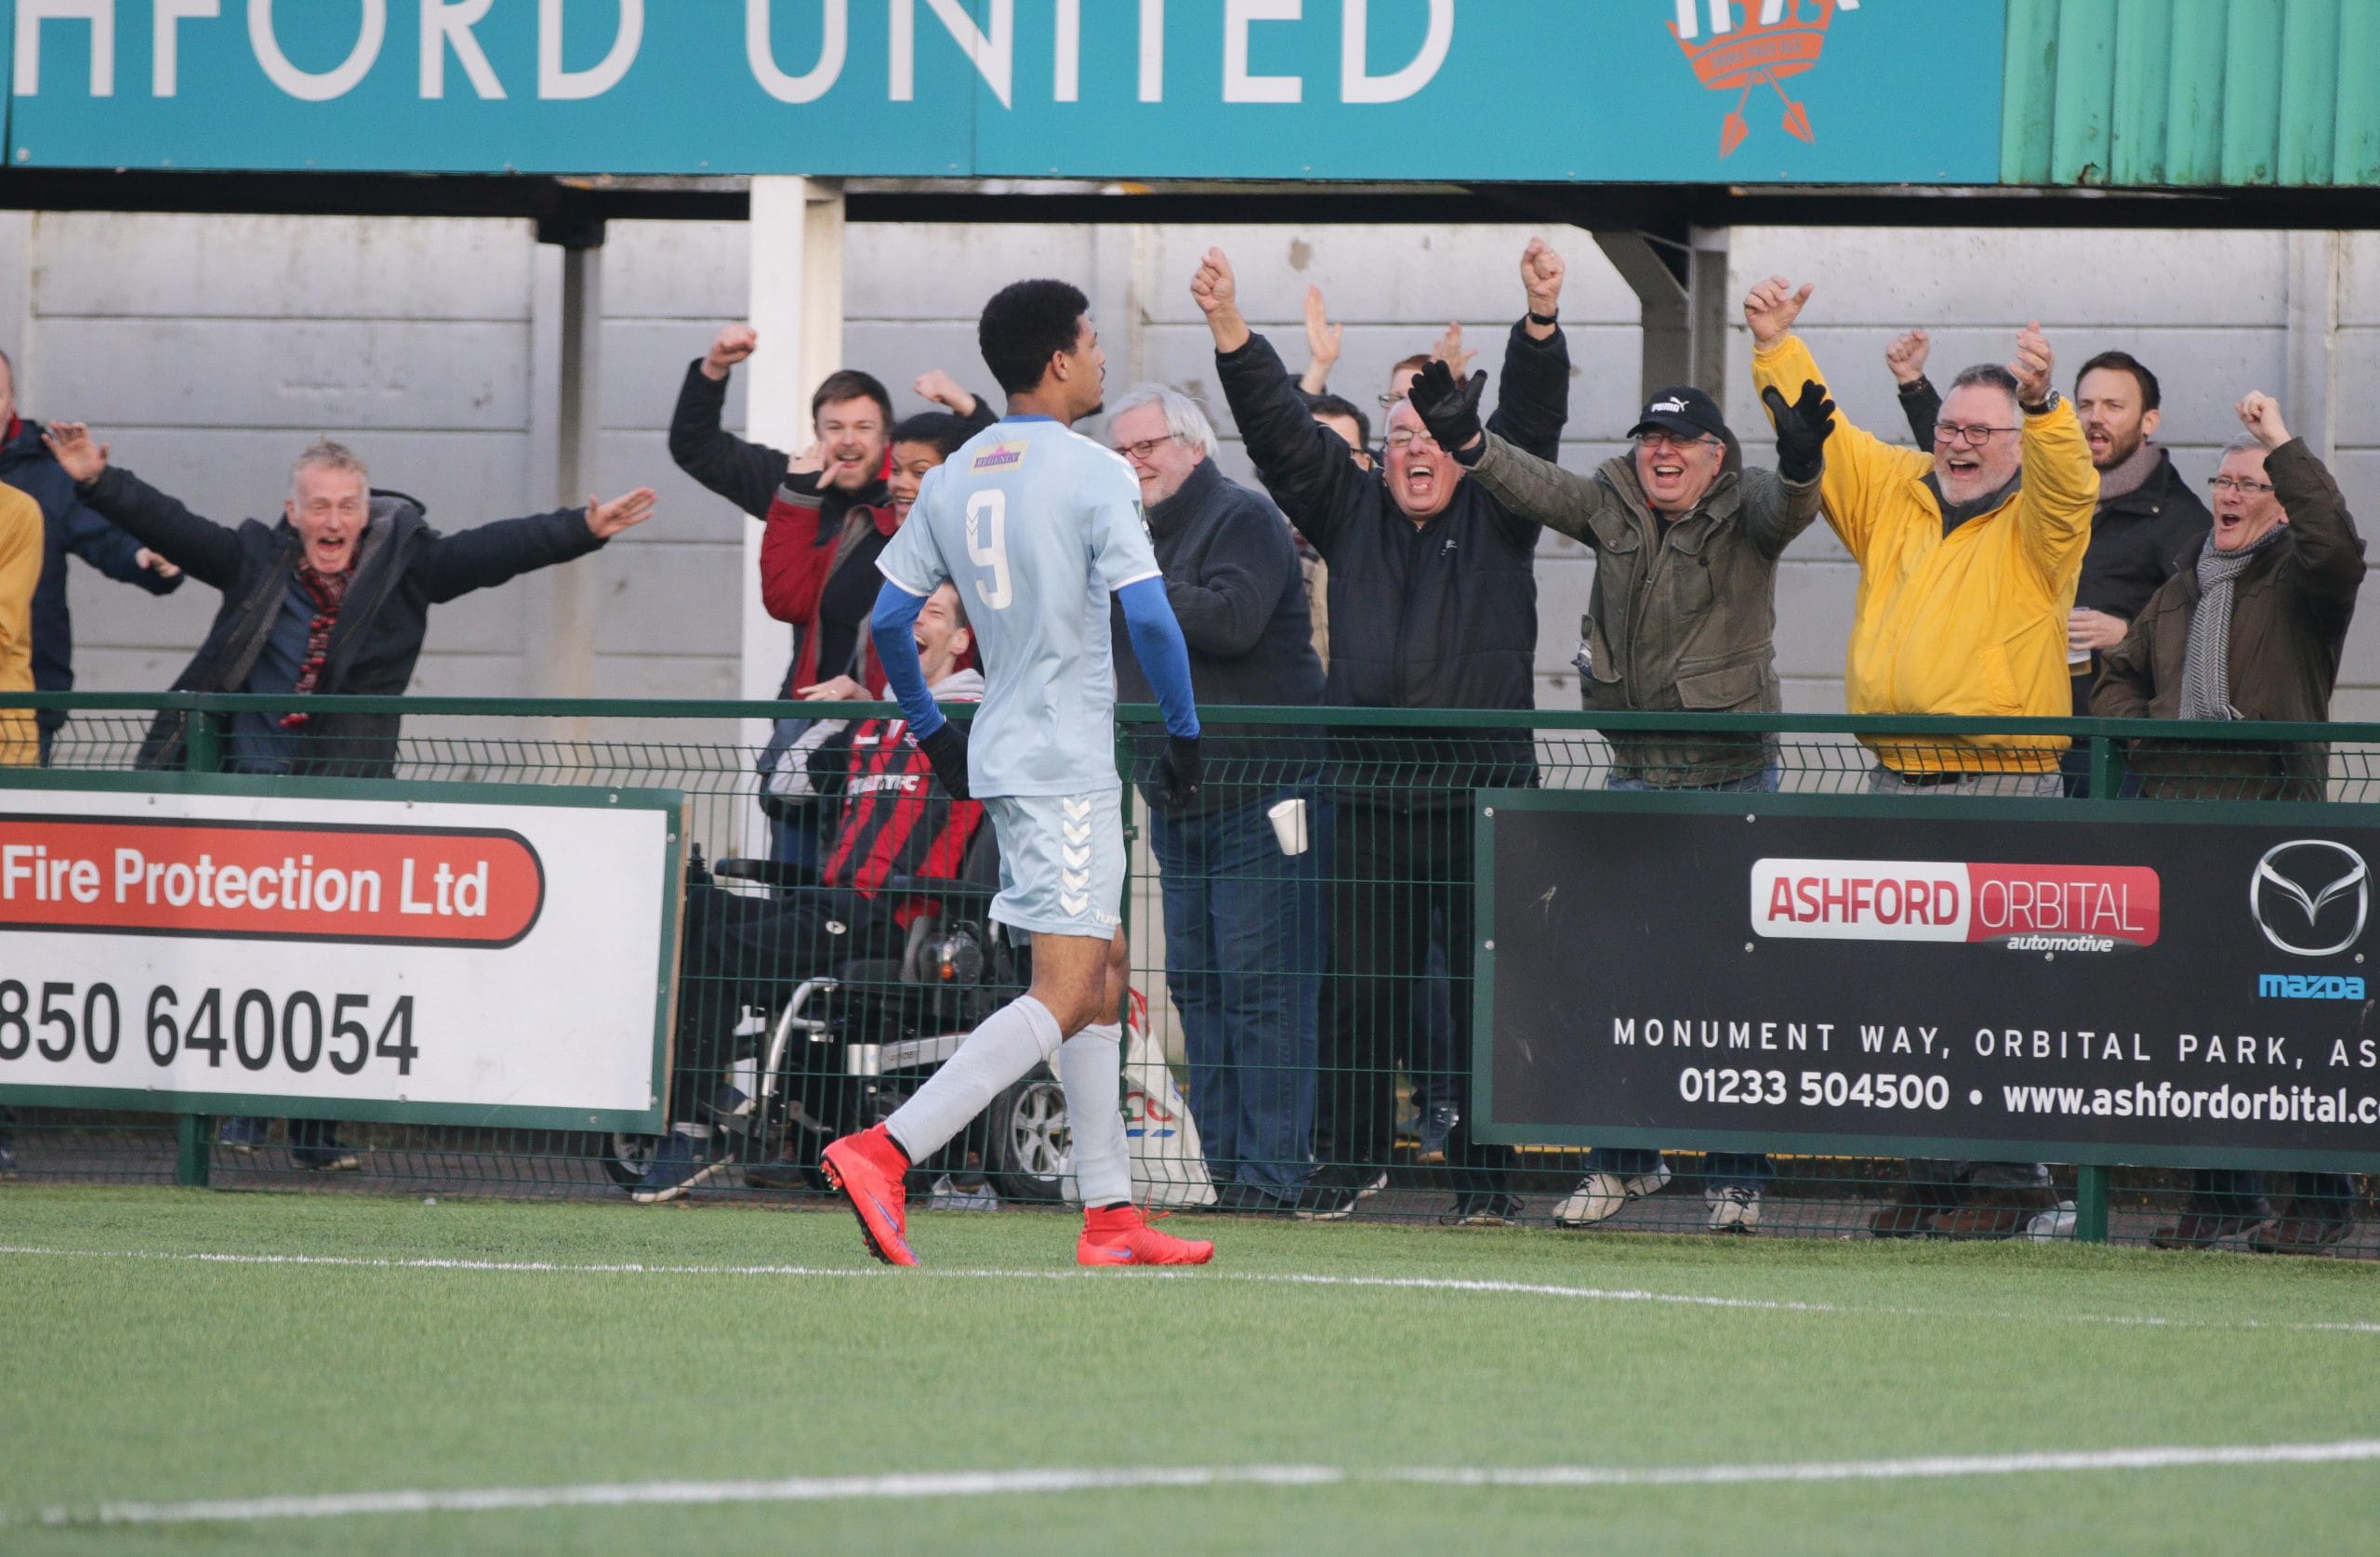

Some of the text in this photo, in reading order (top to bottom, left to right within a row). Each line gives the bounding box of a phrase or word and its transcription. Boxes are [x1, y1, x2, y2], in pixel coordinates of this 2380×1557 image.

[1651, 402, 1680, 413] PUMA
[966, 489, 1012, 610] 9
[3, 844, 489, 917] Fire Protection Ltd
[1768, 877, 2145, 931] ASHFORD ORBITAL
[2007, 934, 2114, 953] automotive
[0, 979, 418, 1076] 850 640054
[1614, 1018, 2378, 1069] MONUMENT WAY, ORBITAL PARK, AS
[1679, 1067, 2380, 1125] 01233 504500 www.ashfordorbital.c
